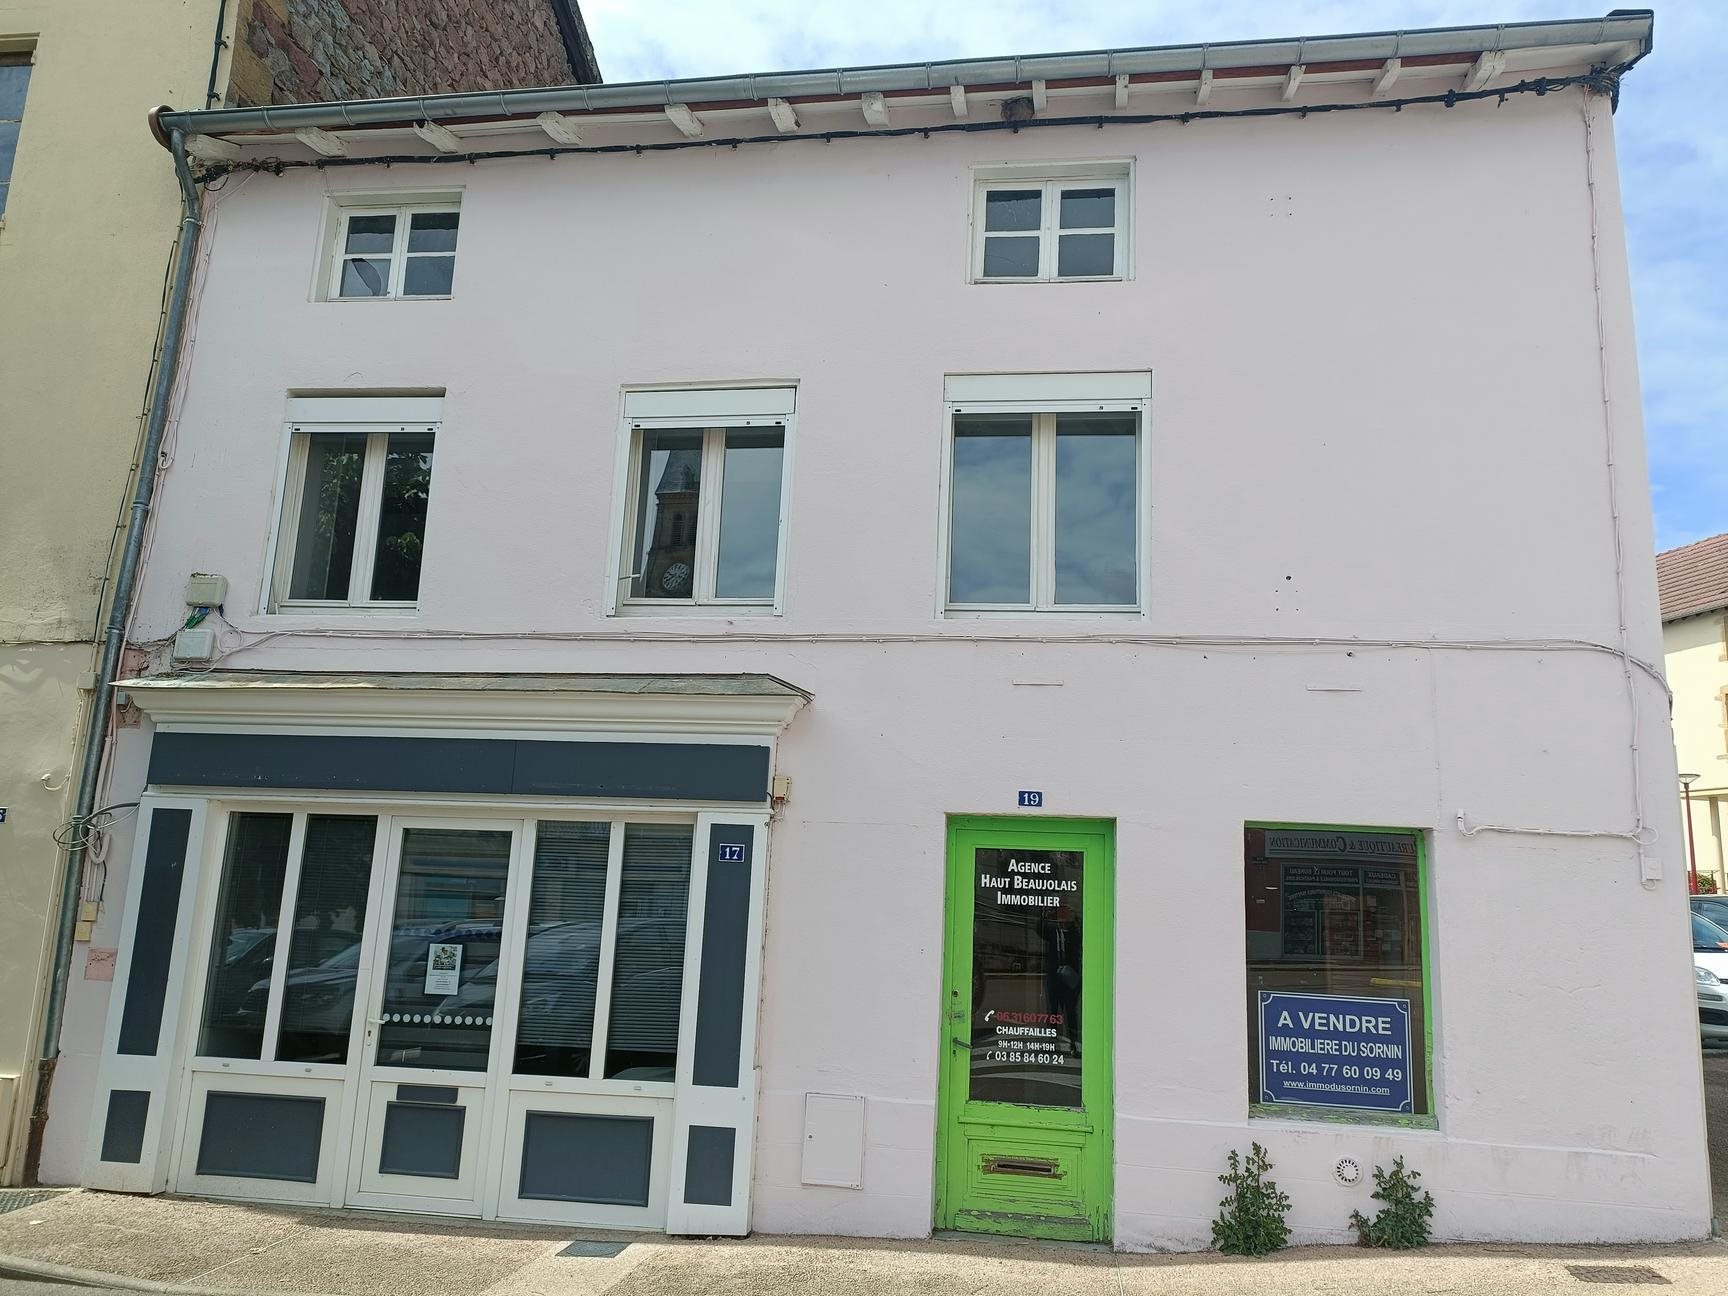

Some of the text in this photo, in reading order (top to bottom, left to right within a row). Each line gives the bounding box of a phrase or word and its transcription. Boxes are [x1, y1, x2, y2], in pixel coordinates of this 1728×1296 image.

[1023, 793, 1039, 805] 19
[724, 847, 740, 859] 17
[1008, 859, 1051, 874] AGENCE
[981, 874, 1077, 891] HAUT BEAUJOLAIS
[997, 891, 1060, 907] IMMOBILIER
[996, 1025, 1057, 1037] CHAUFFAILLES
[1277, 1011, 1392, 1035] A VENDRE
[1269, 1036, 1402, 1059] IMMOBILIERE DU SORNIN
[995, 1051, 1065, 1065] 03 85 84 60 24
[1270, 1060, 1402, 1081] Tél. 04 77 60 09 49
[1283, 1079, 1390, 1095] www.immodusornin.com
